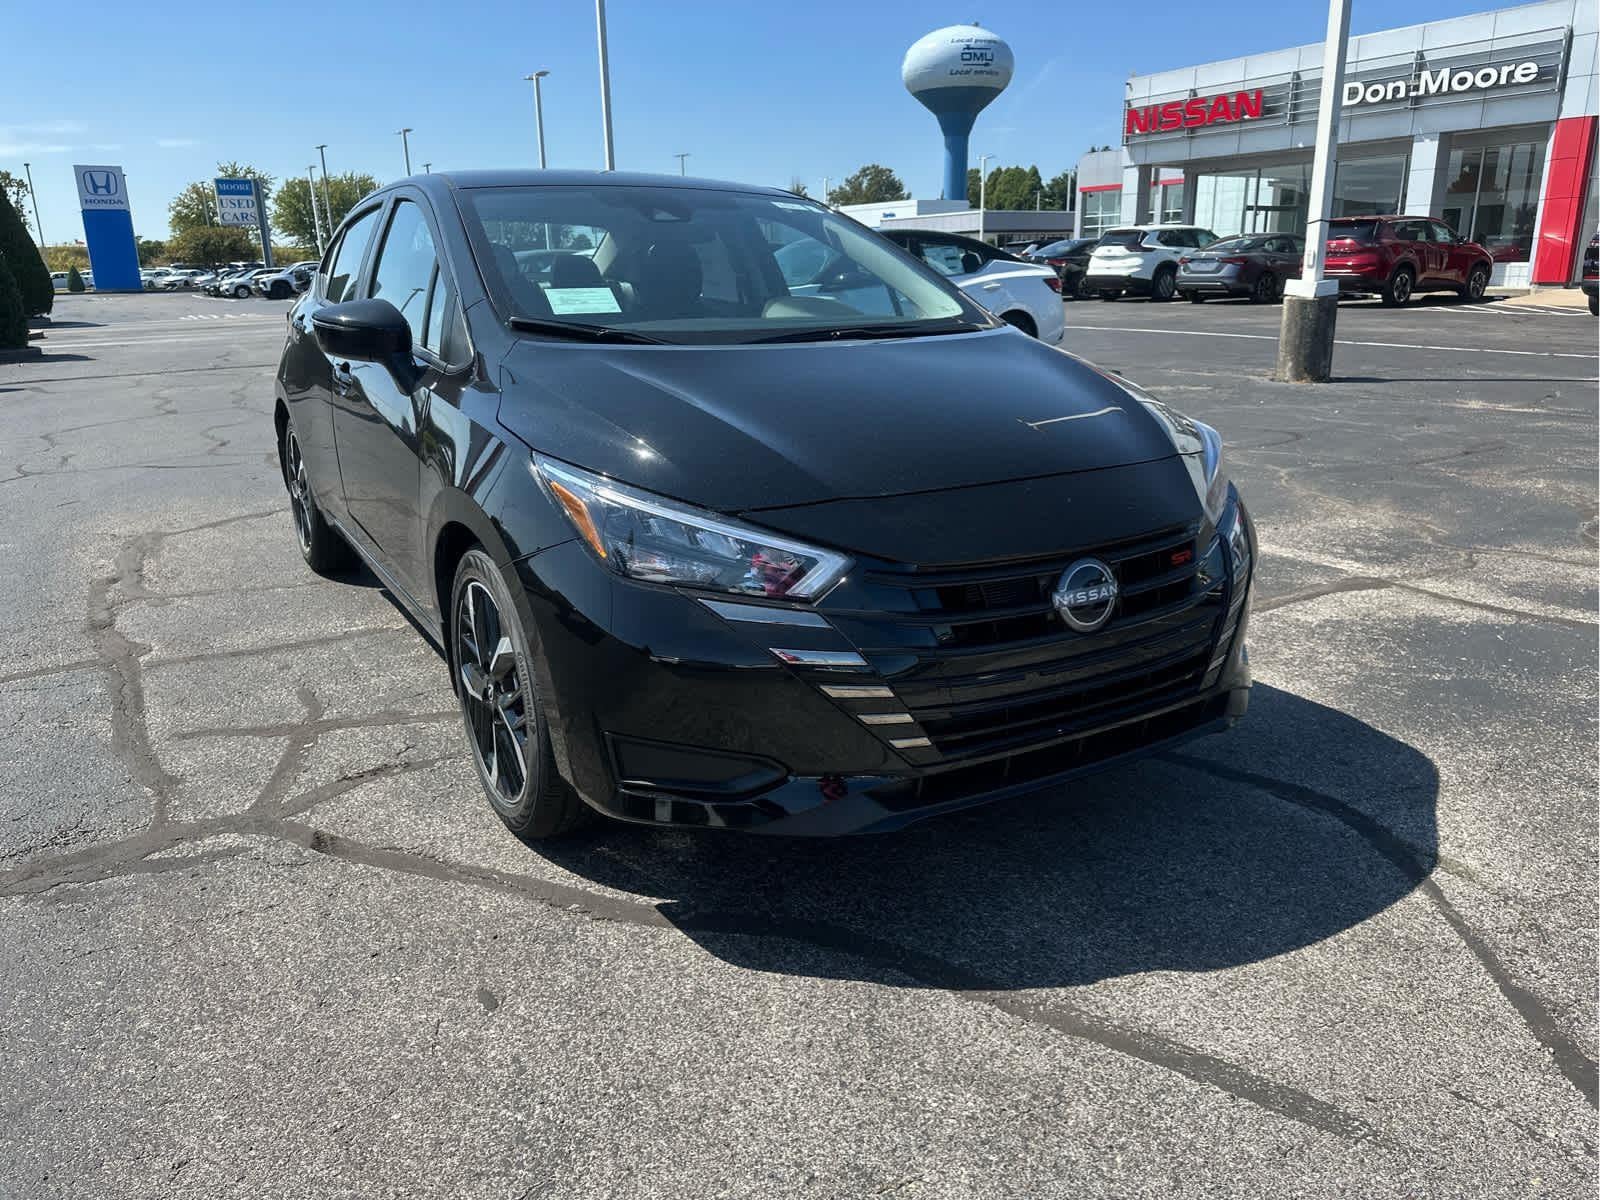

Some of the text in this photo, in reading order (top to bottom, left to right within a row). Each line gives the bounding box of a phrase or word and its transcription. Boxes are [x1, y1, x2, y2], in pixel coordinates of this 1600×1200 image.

[960, 51, 994, 62] OMU
[1342, 61, 1539, 106] Don Moore
[1126, 89, 1263, 135] NISSAN
[218, 183, 251, 191] MOORE
[220, 198, 256, 209] USED
[221, 211, 258, 222] CARS
[1054, 584, 1118, 608] NISSAN
